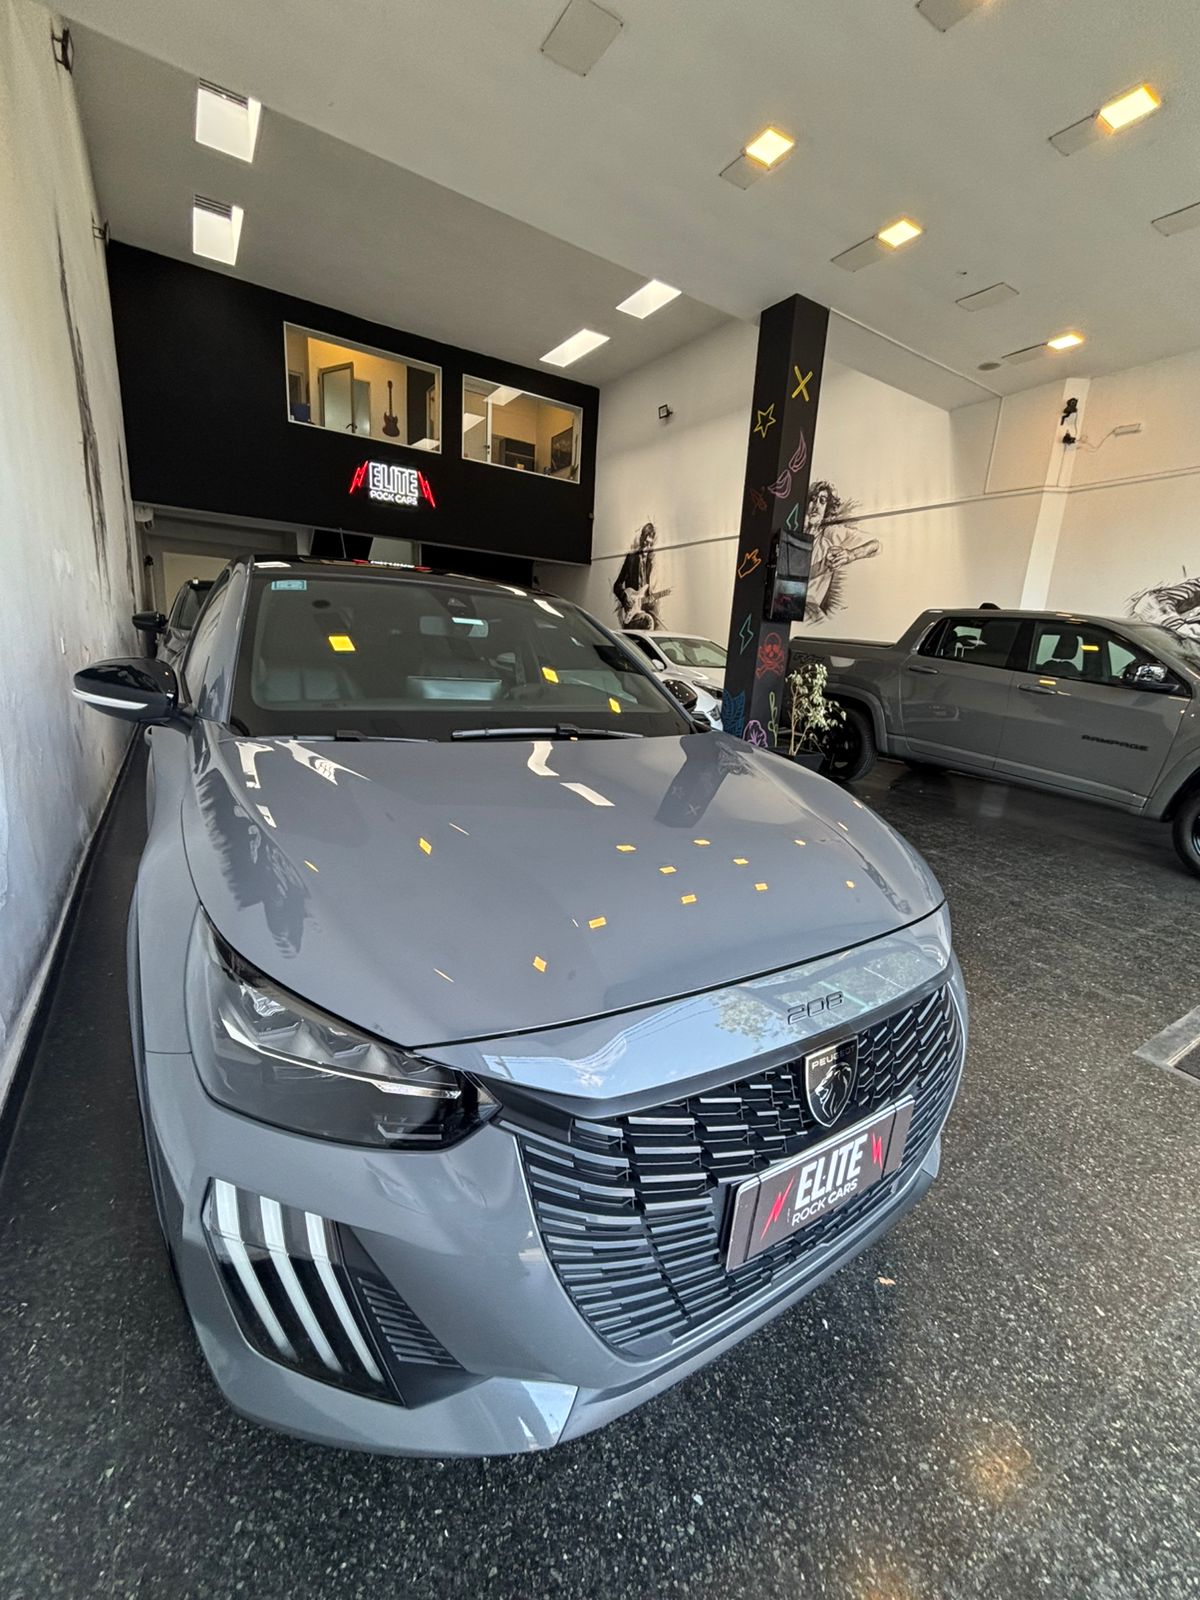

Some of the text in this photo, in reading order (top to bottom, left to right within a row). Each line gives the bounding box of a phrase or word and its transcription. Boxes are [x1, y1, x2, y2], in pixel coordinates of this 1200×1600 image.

[369, 462, 418, 497] ELITE
[369, 490, 418, 506] ROCK CARS
[787, 991, 843, 1025] 208
[795, 1134, 868, 1211] ELITE
[791, 1178, 858, 1226] ROCK CARS
